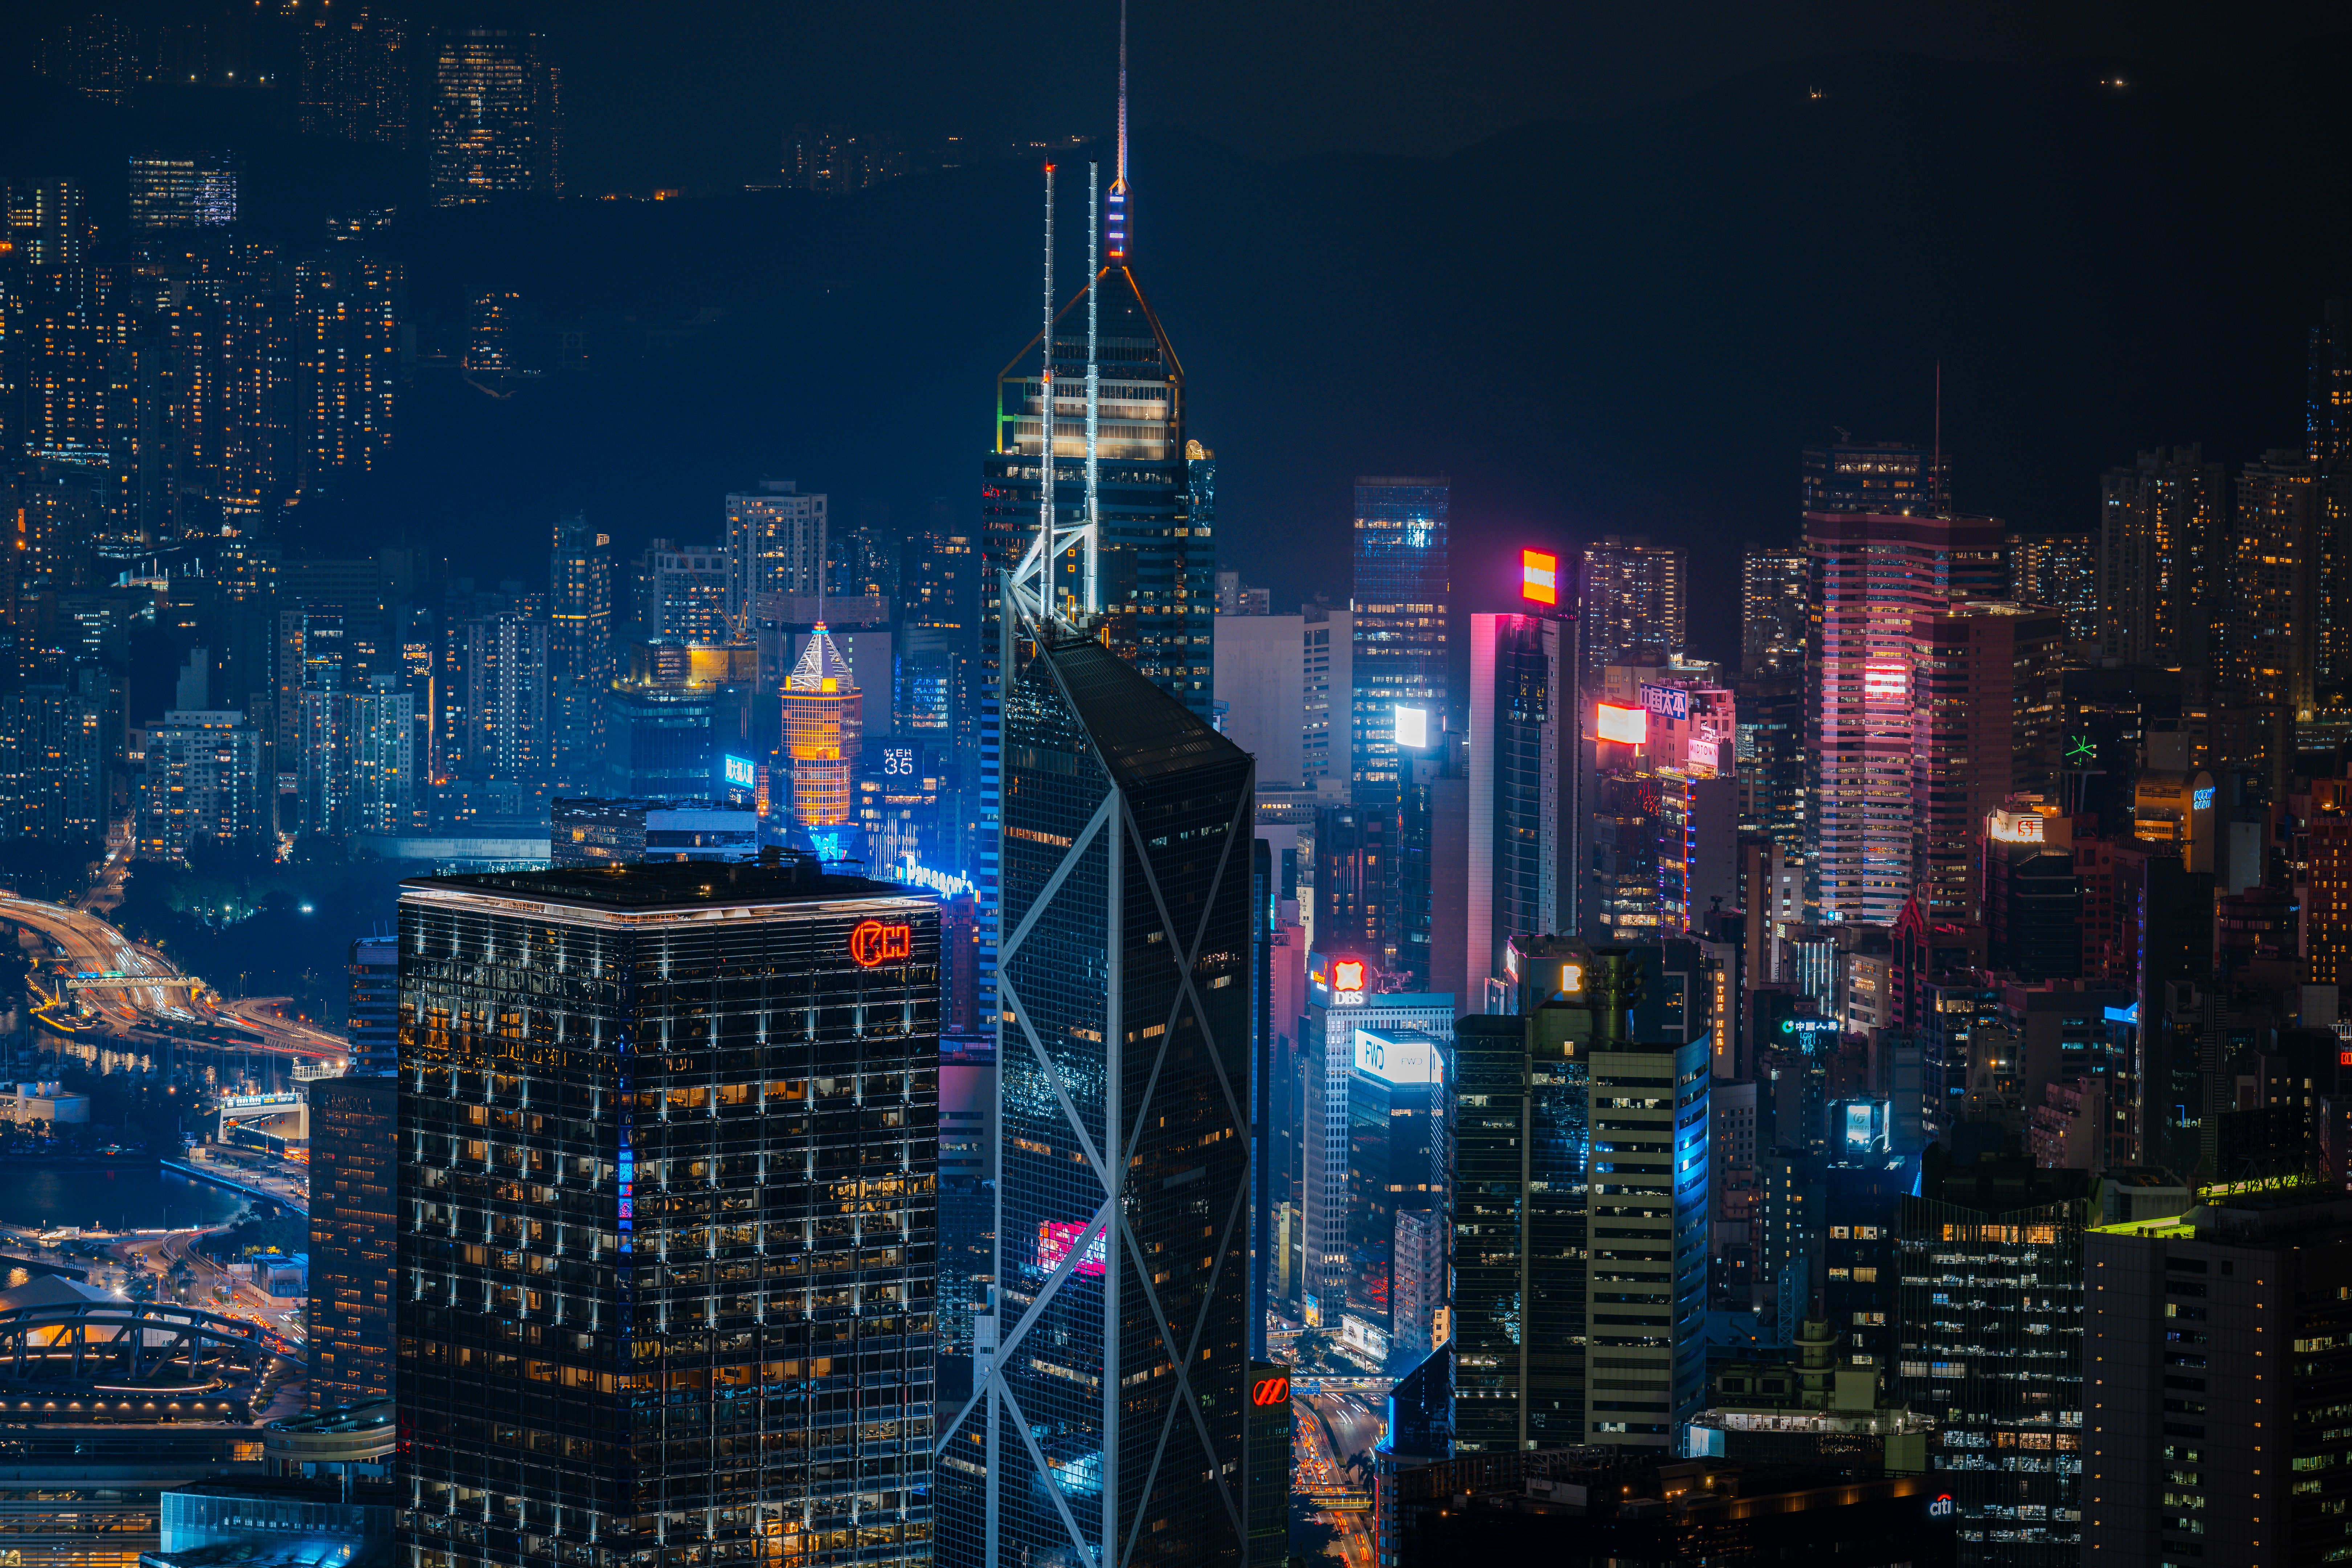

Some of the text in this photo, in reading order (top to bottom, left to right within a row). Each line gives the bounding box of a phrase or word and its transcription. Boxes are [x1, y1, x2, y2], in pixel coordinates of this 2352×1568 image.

[1640, 686, 1685, 717] 中国太平
[1690, 743, 1717, 757] MIDTOWN
[884, 757, 913, 775] 35
[1313, 971, 1325, 985] Different
[1335, 991, 1363, 1004] DBS
[1365, 1040, 1384, 1070] FWD
[1930, 1498, 1951, 1516] citi
